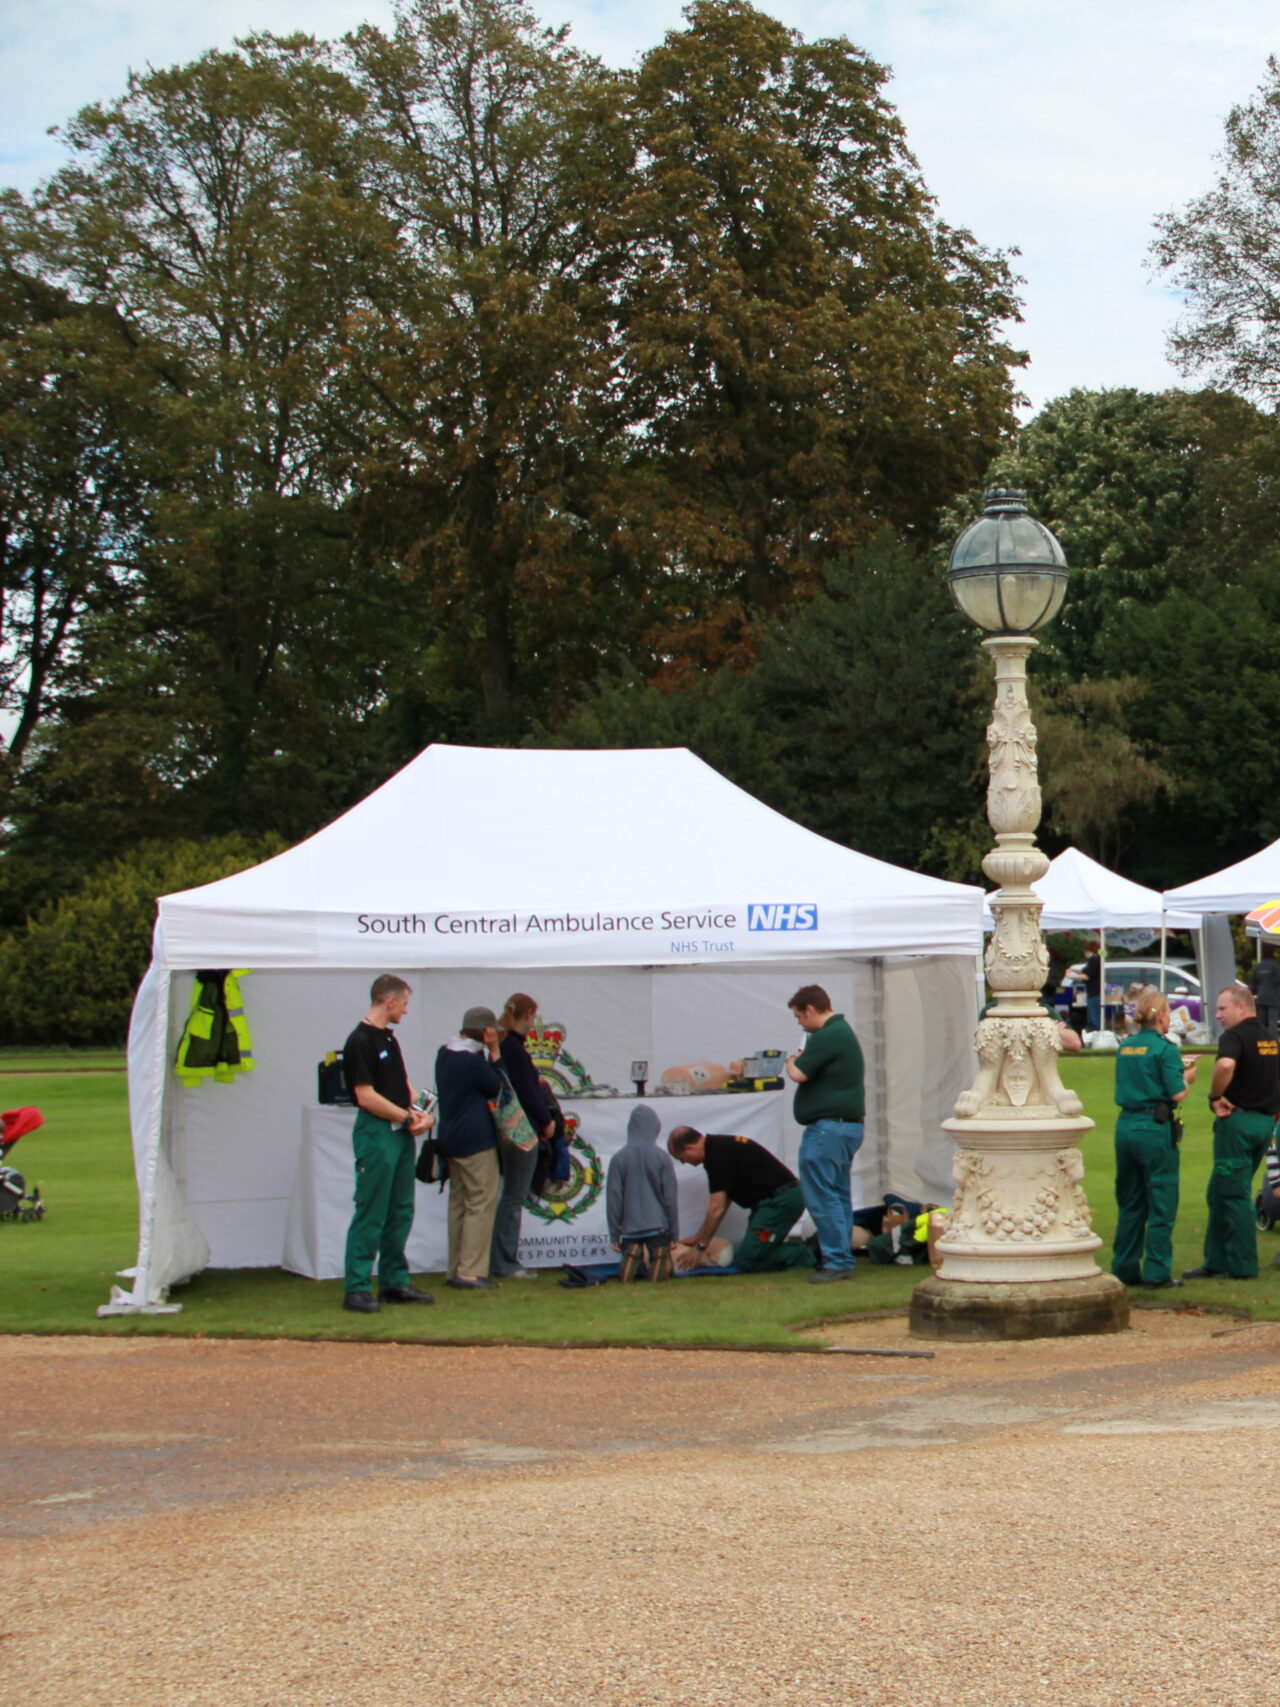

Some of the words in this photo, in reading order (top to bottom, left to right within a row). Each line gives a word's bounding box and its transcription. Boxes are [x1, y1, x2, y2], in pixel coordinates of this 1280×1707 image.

[358, 914, 426, 934] South
[434, 913, 517, 934] Central
[525, 912, 654, 932] Ambulance
[661, 909, 736, 930] Service
[749, 904, 816, 931] NHS
[670, 941, 698, 953] NHS
[703, 940, 735, 952] Trust
[518, 1236, 578, 1247] OMMUNITY
[582, 1234, 609, 1244] FIRST
[518, 1247, 608, 1260] ESPONDERS
